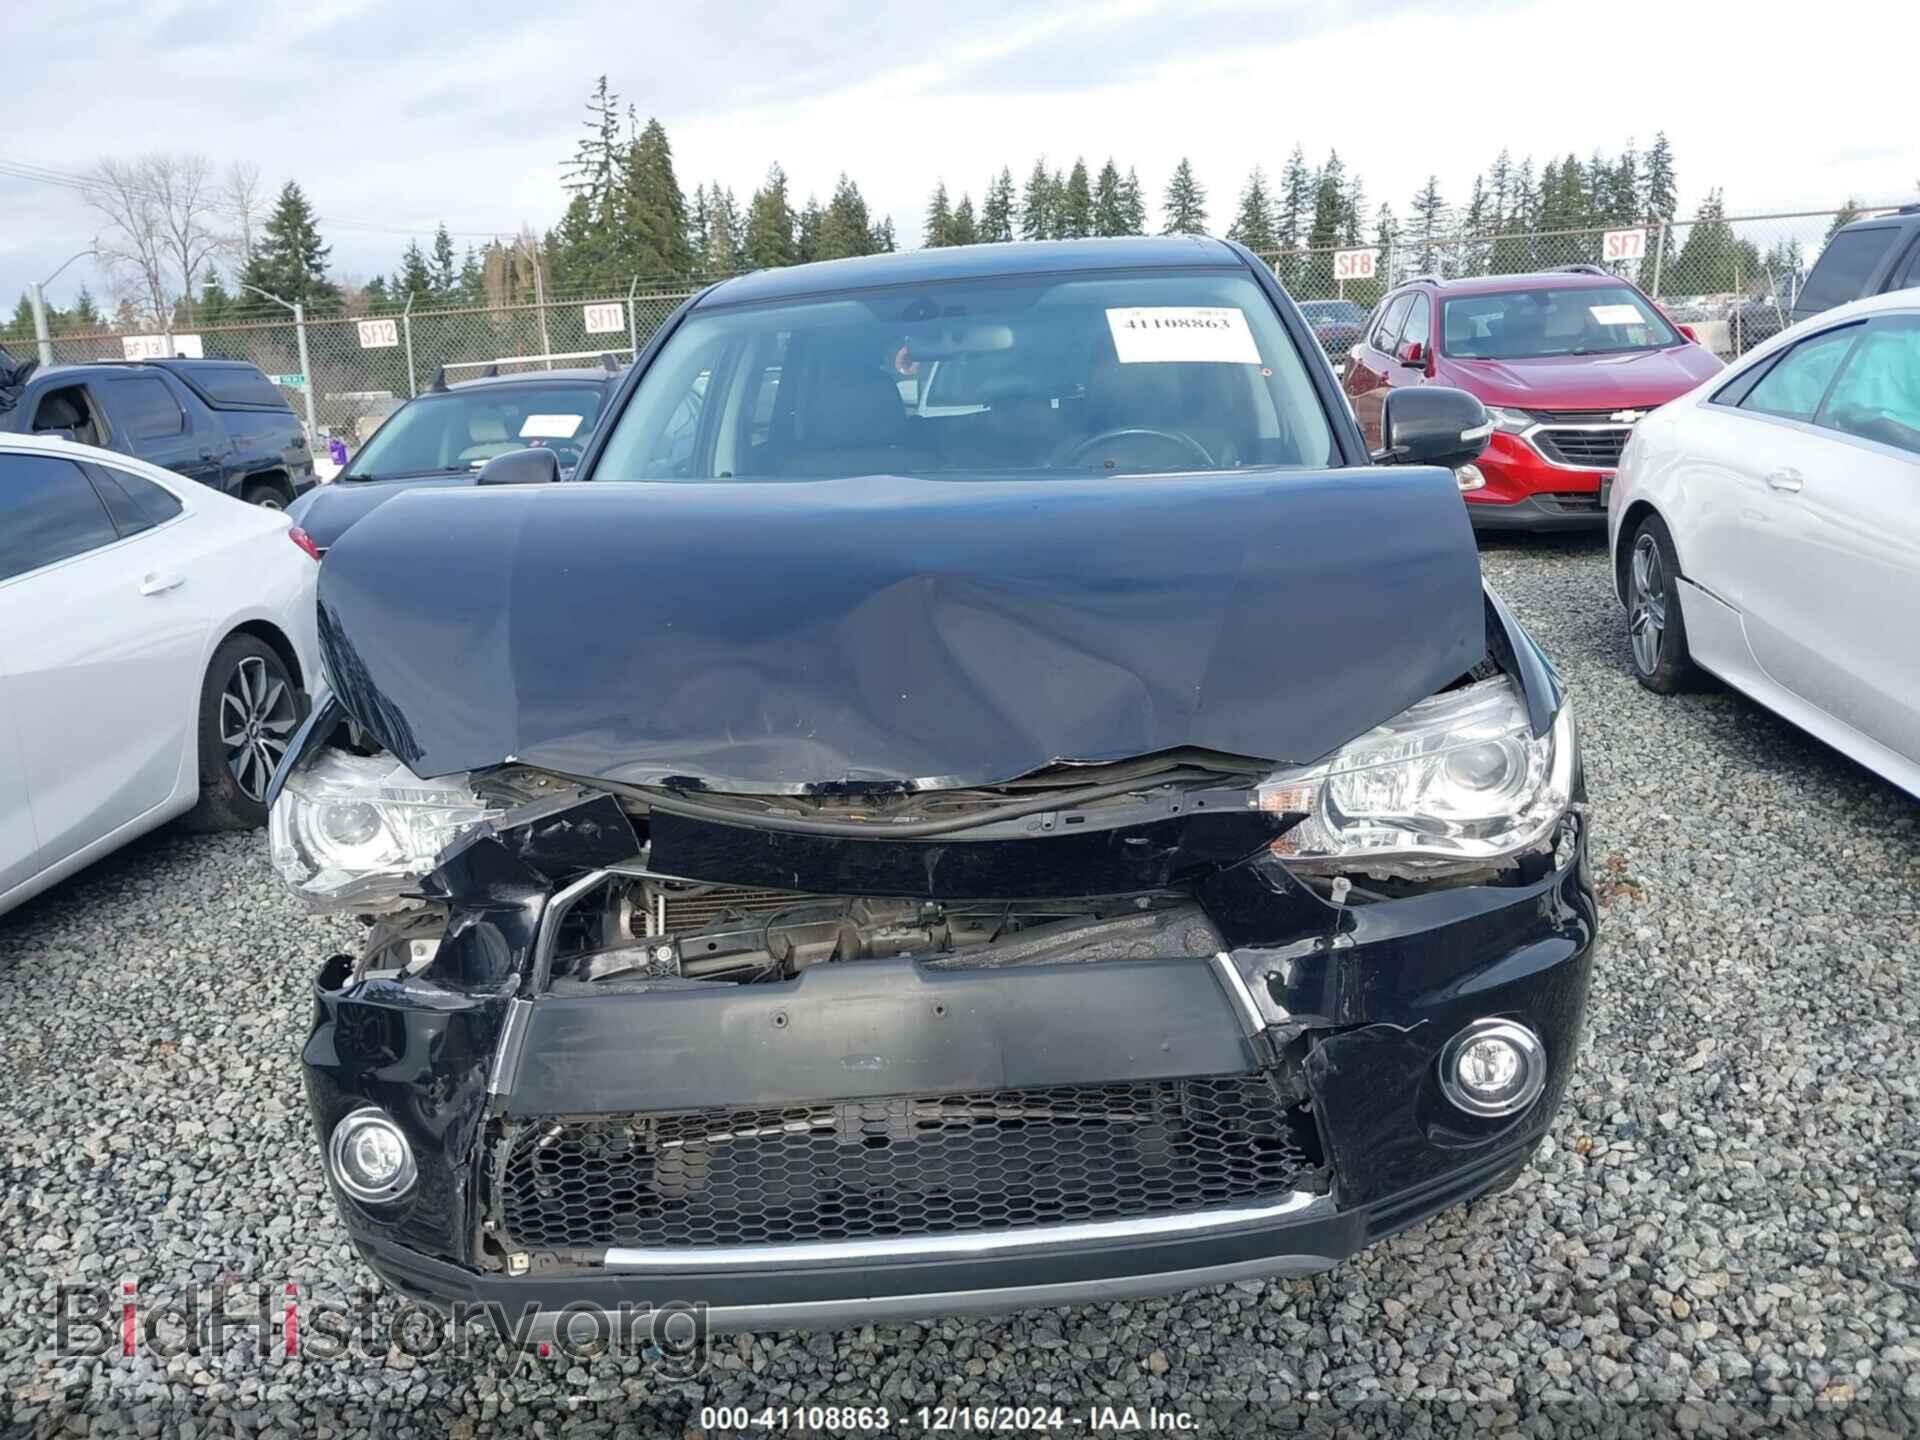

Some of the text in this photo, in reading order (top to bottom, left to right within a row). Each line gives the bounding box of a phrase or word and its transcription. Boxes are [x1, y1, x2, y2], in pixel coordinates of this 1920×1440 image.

[1608, 234, 1640, 257] SF7
[589, 309, 619, 329] SF11
[1122, 318, 1231, 330] 41108863
[361, 323, 396, 345] SF12
